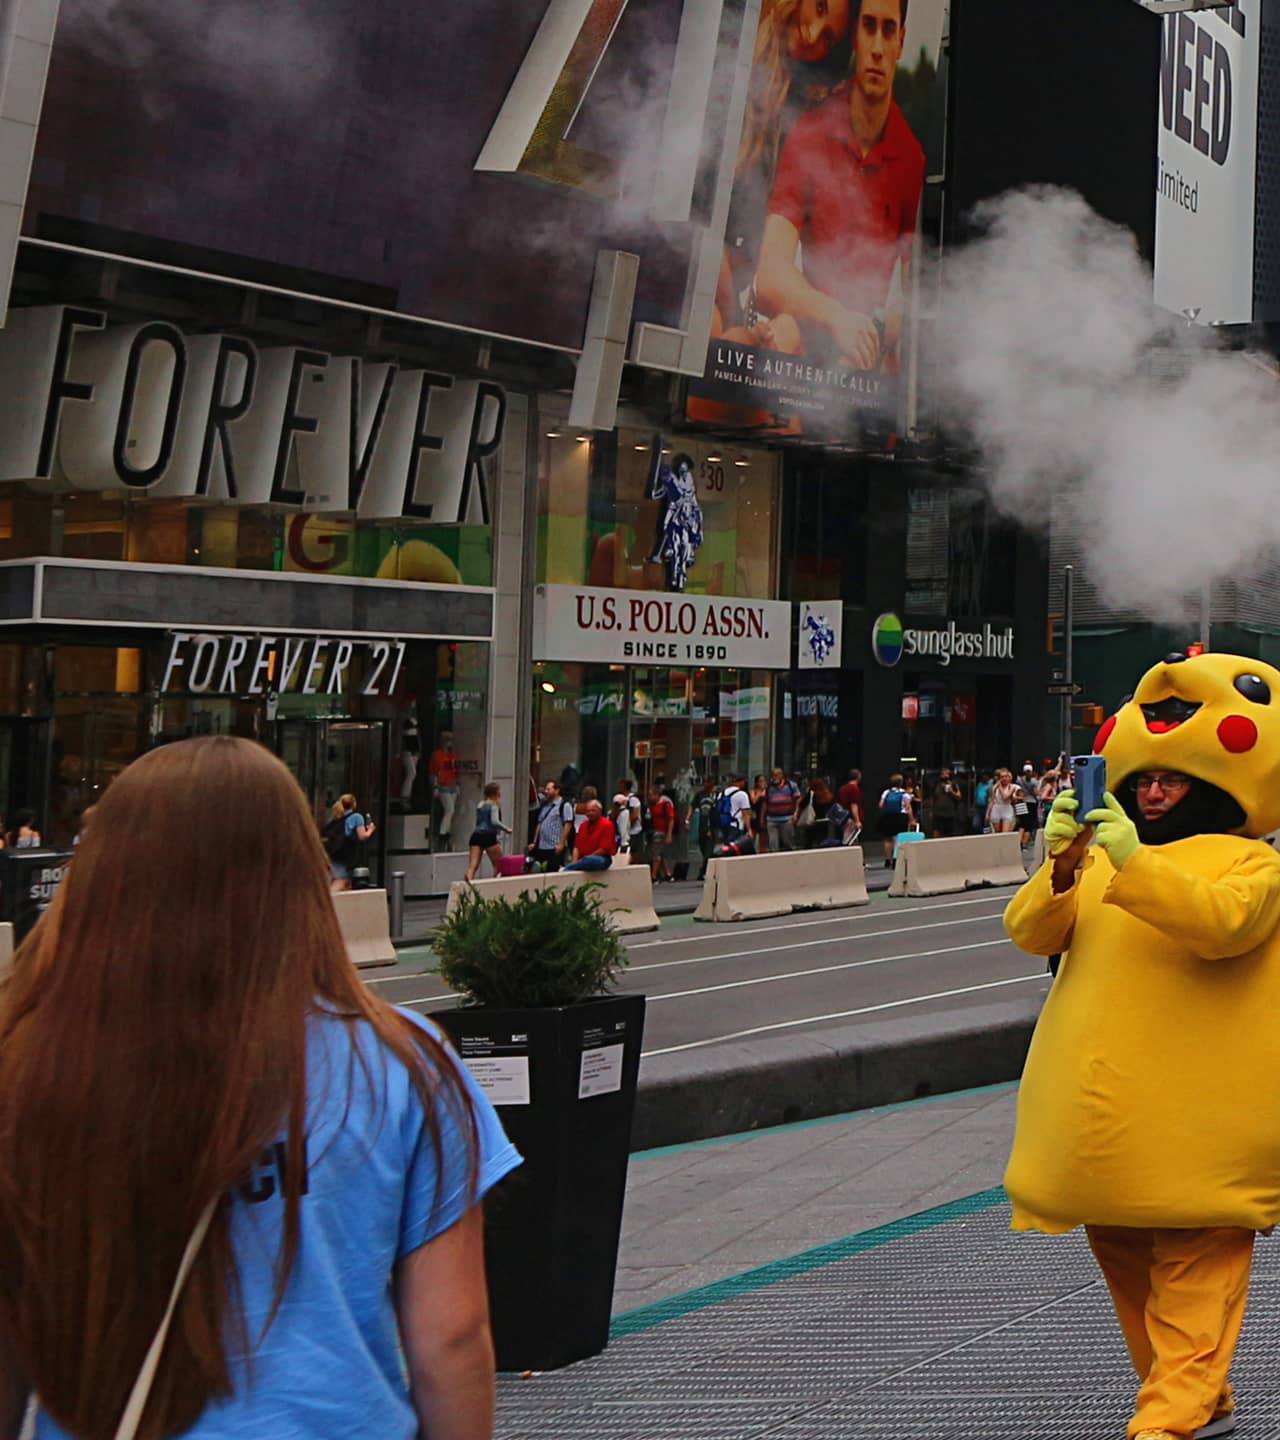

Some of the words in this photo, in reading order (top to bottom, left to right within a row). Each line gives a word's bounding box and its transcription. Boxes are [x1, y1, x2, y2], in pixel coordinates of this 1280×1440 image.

[717, 347, 755, 370] LIVE
[20, 304, 509, 527] FOREVER
[575, 595, 622, 632] U.S.
[628, 599, 697, 636] POLO
[702, 604, 770, 641] ASSN.
[161, 630, 352, 696] FOREVER
[363, 641, 408, 697] 21
[623, 640, 678, 660] SINCE
[684, 641, 728, 661] 1890
[903, 621, 983, 665] sunglass
[983, 622, 1015, 660] hut
